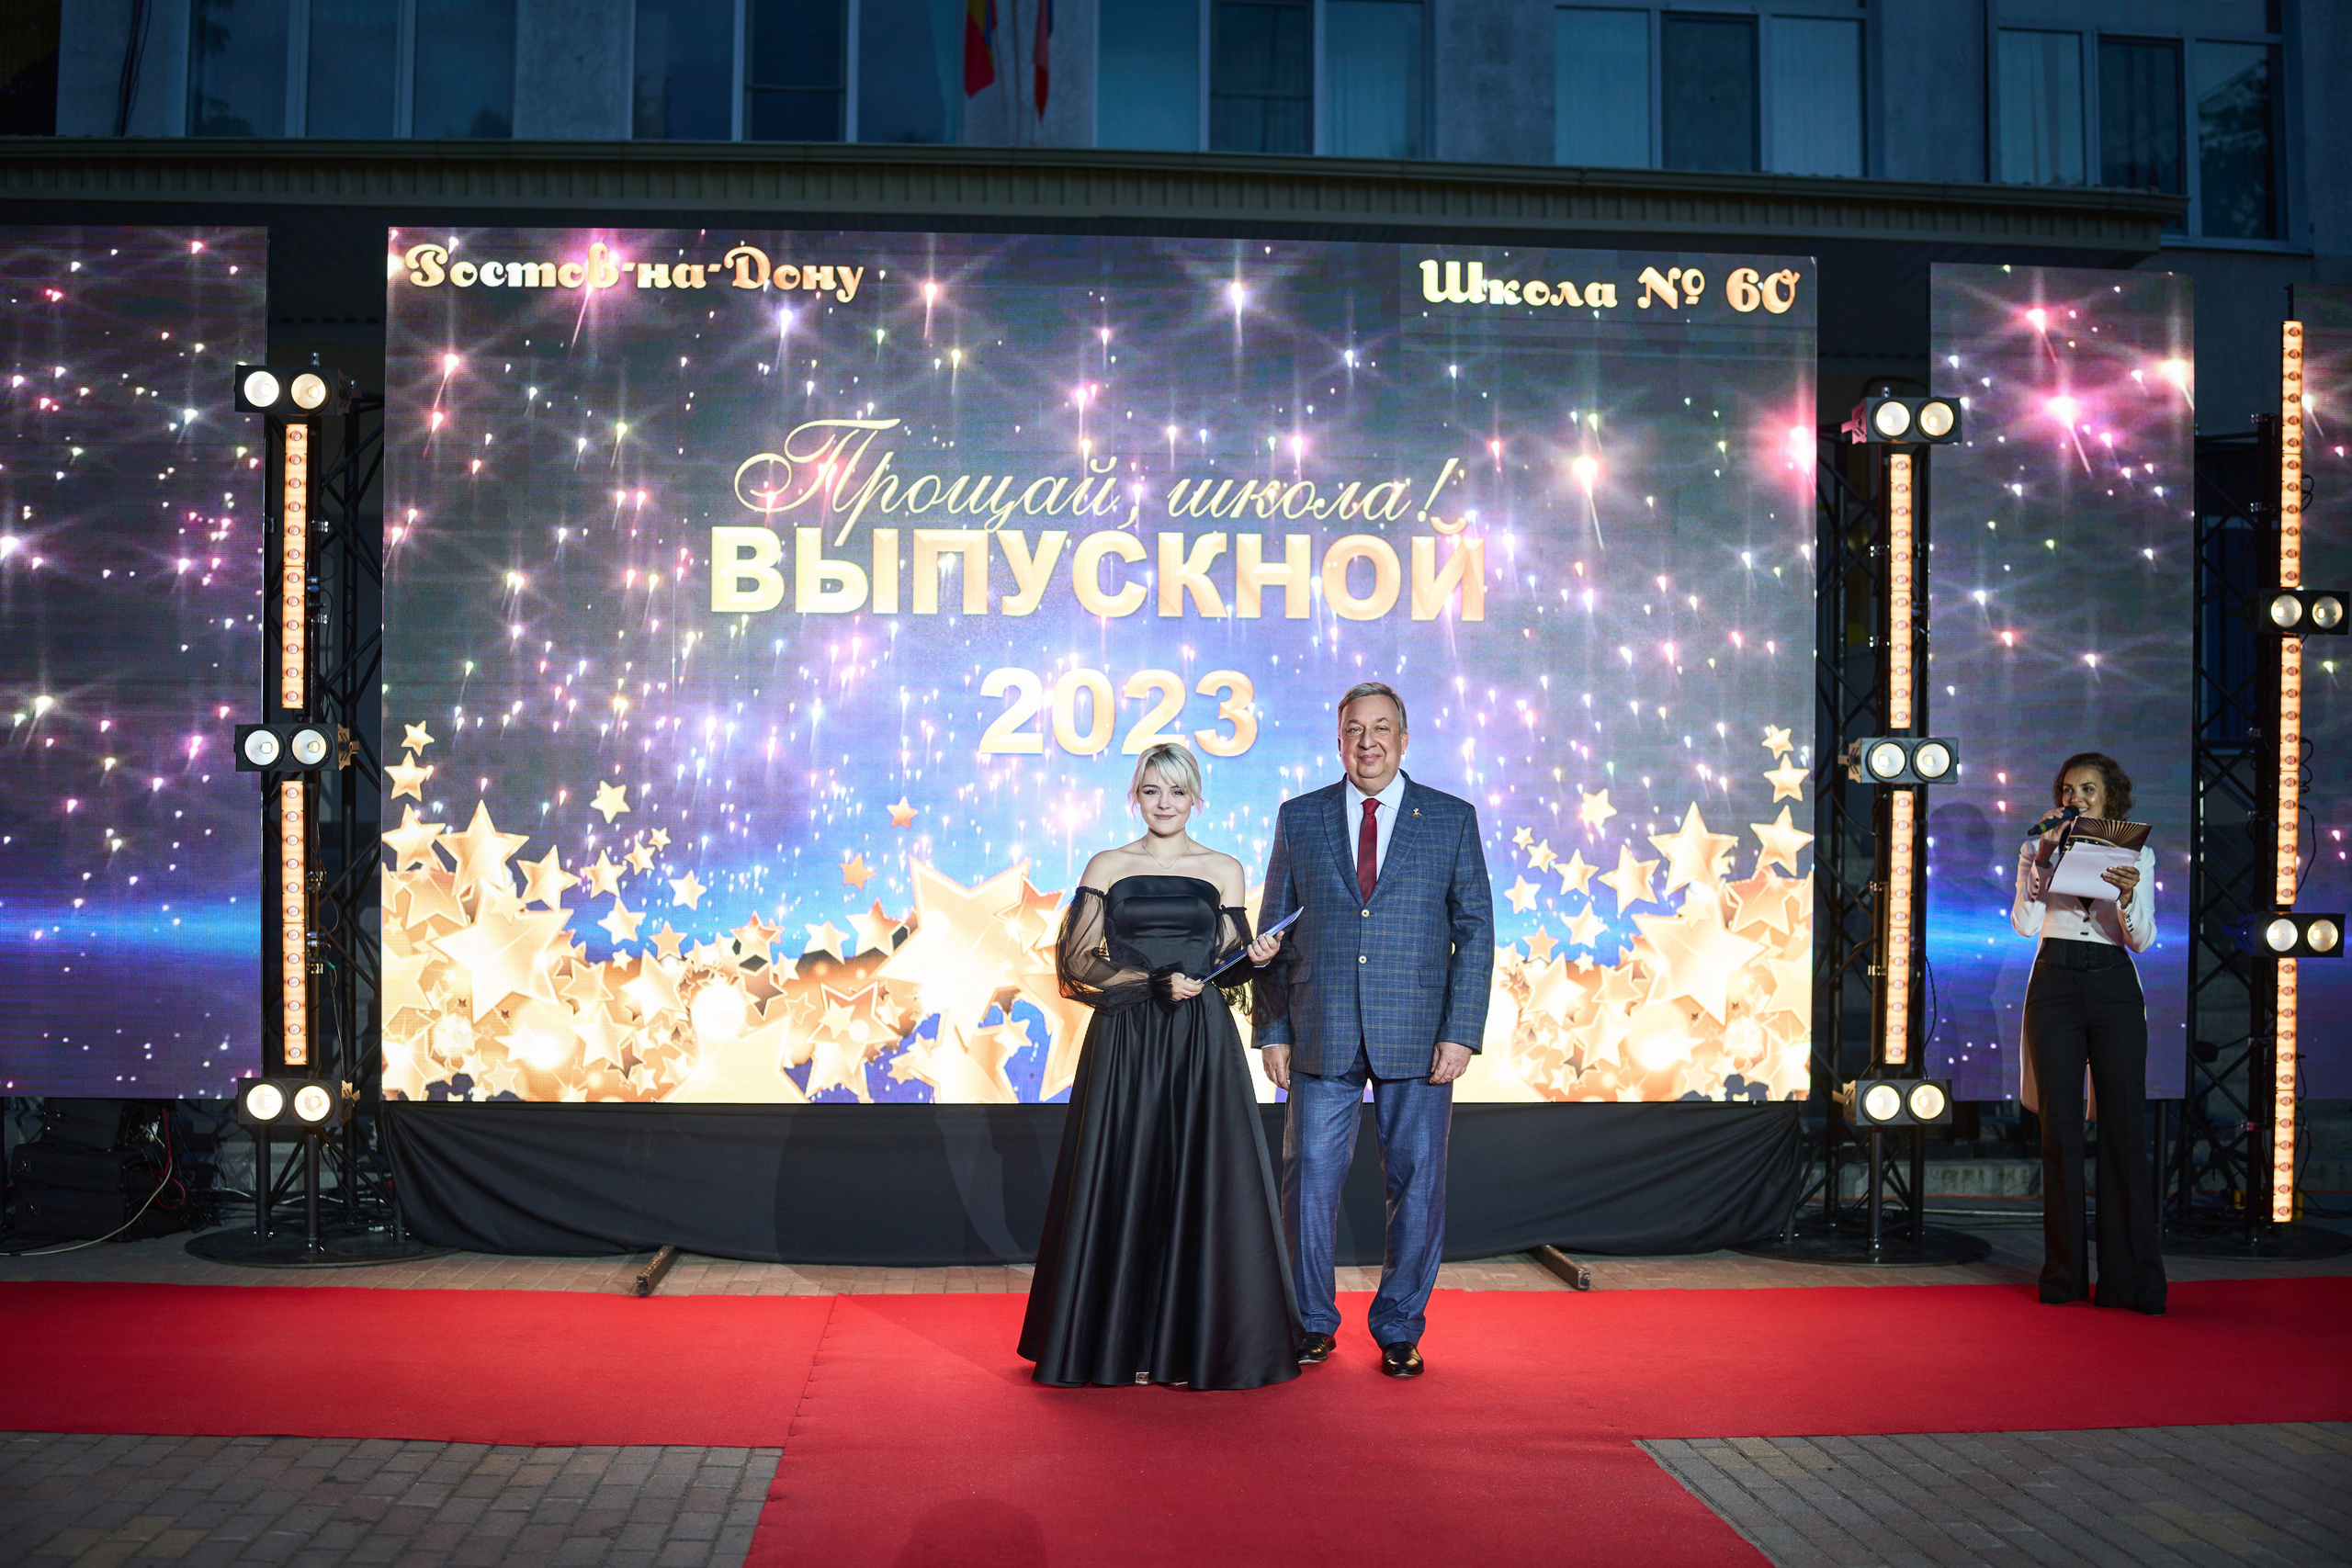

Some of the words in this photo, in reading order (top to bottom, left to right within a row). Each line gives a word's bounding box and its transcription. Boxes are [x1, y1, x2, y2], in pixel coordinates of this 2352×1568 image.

[404, 242, 865, 303] Ростов-на-Дону
[1418, 259, 1618, 309] Школа
[1636, 265, 1706, 310] №
[1725, 266, 1801, 314] 60
[733, 418, 1140, 546] Прощай,
[1167, 457, 1460, 523] школа!
[710, 515, 1487, 622] ВЫПУСКНОЙ
[978, 667, 1259, 757] 2023
